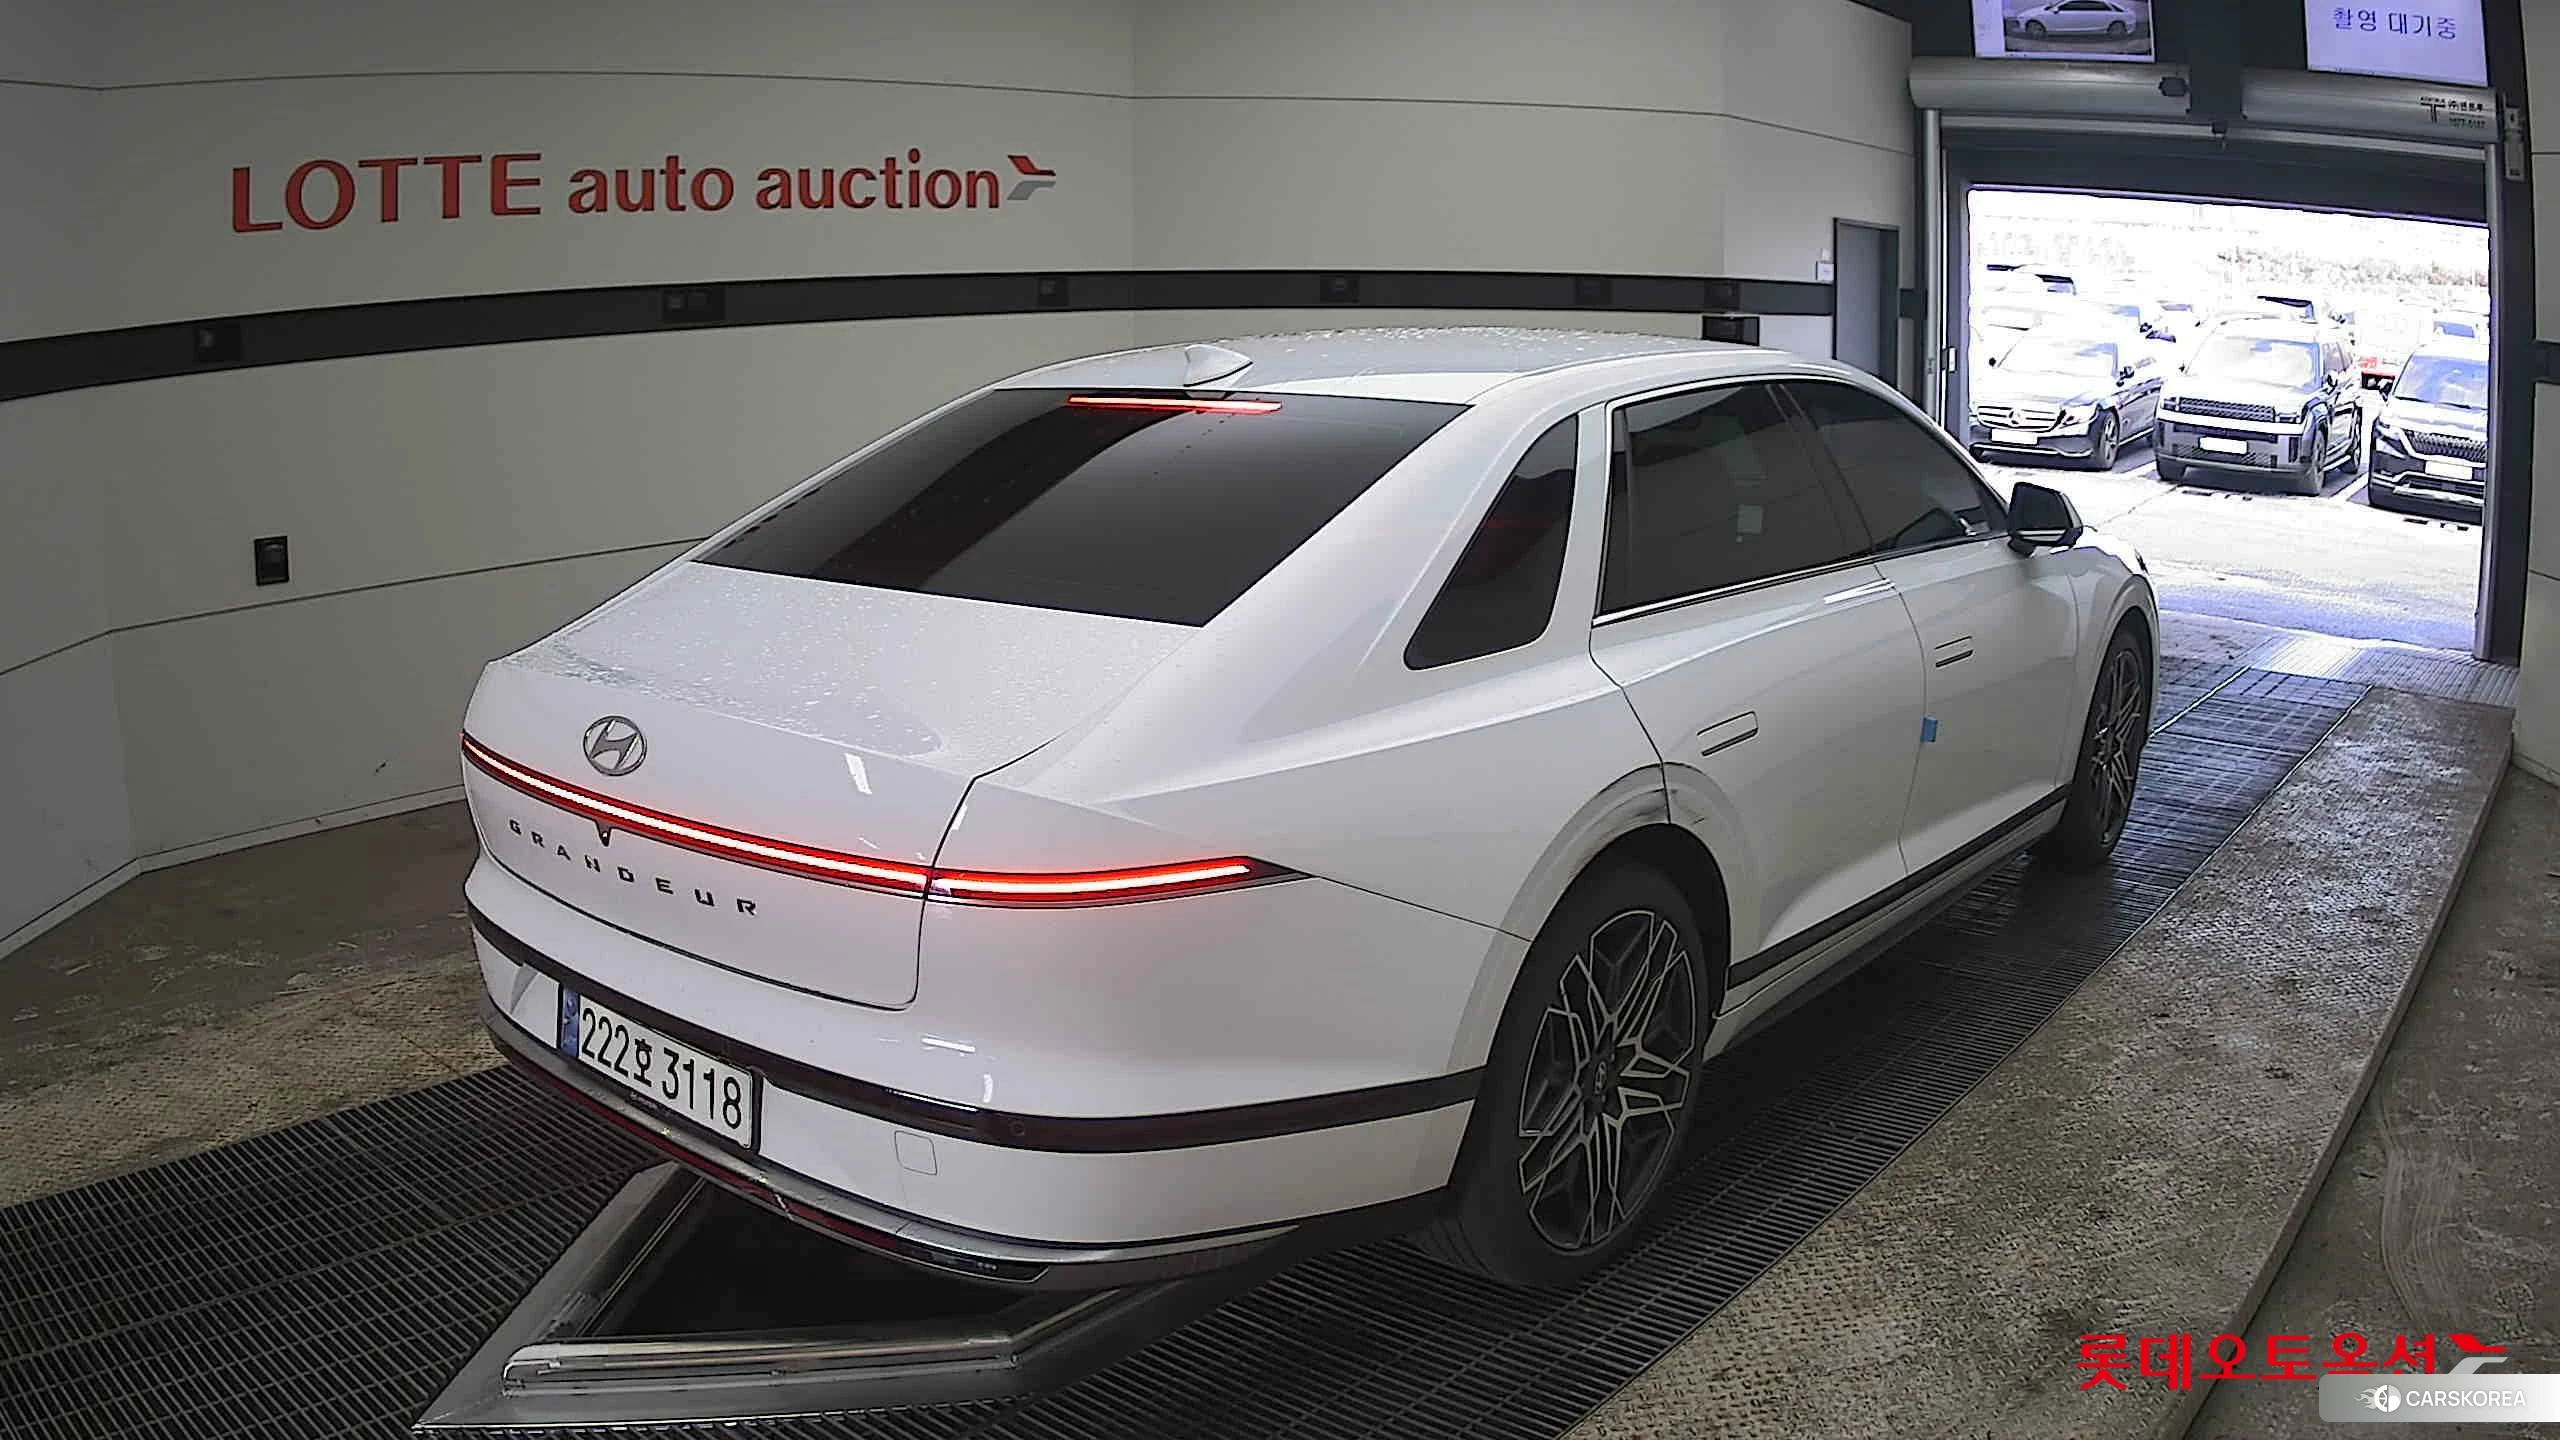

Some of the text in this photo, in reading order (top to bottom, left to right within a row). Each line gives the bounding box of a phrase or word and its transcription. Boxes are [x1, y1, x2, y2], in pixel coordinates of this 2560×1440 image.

[2333, 7, 2457, 40] 촬영 대기중
[232, 150, 1001, 233] LOTTE auto auction
[508, 818, 758, 916] GRANDEUR
